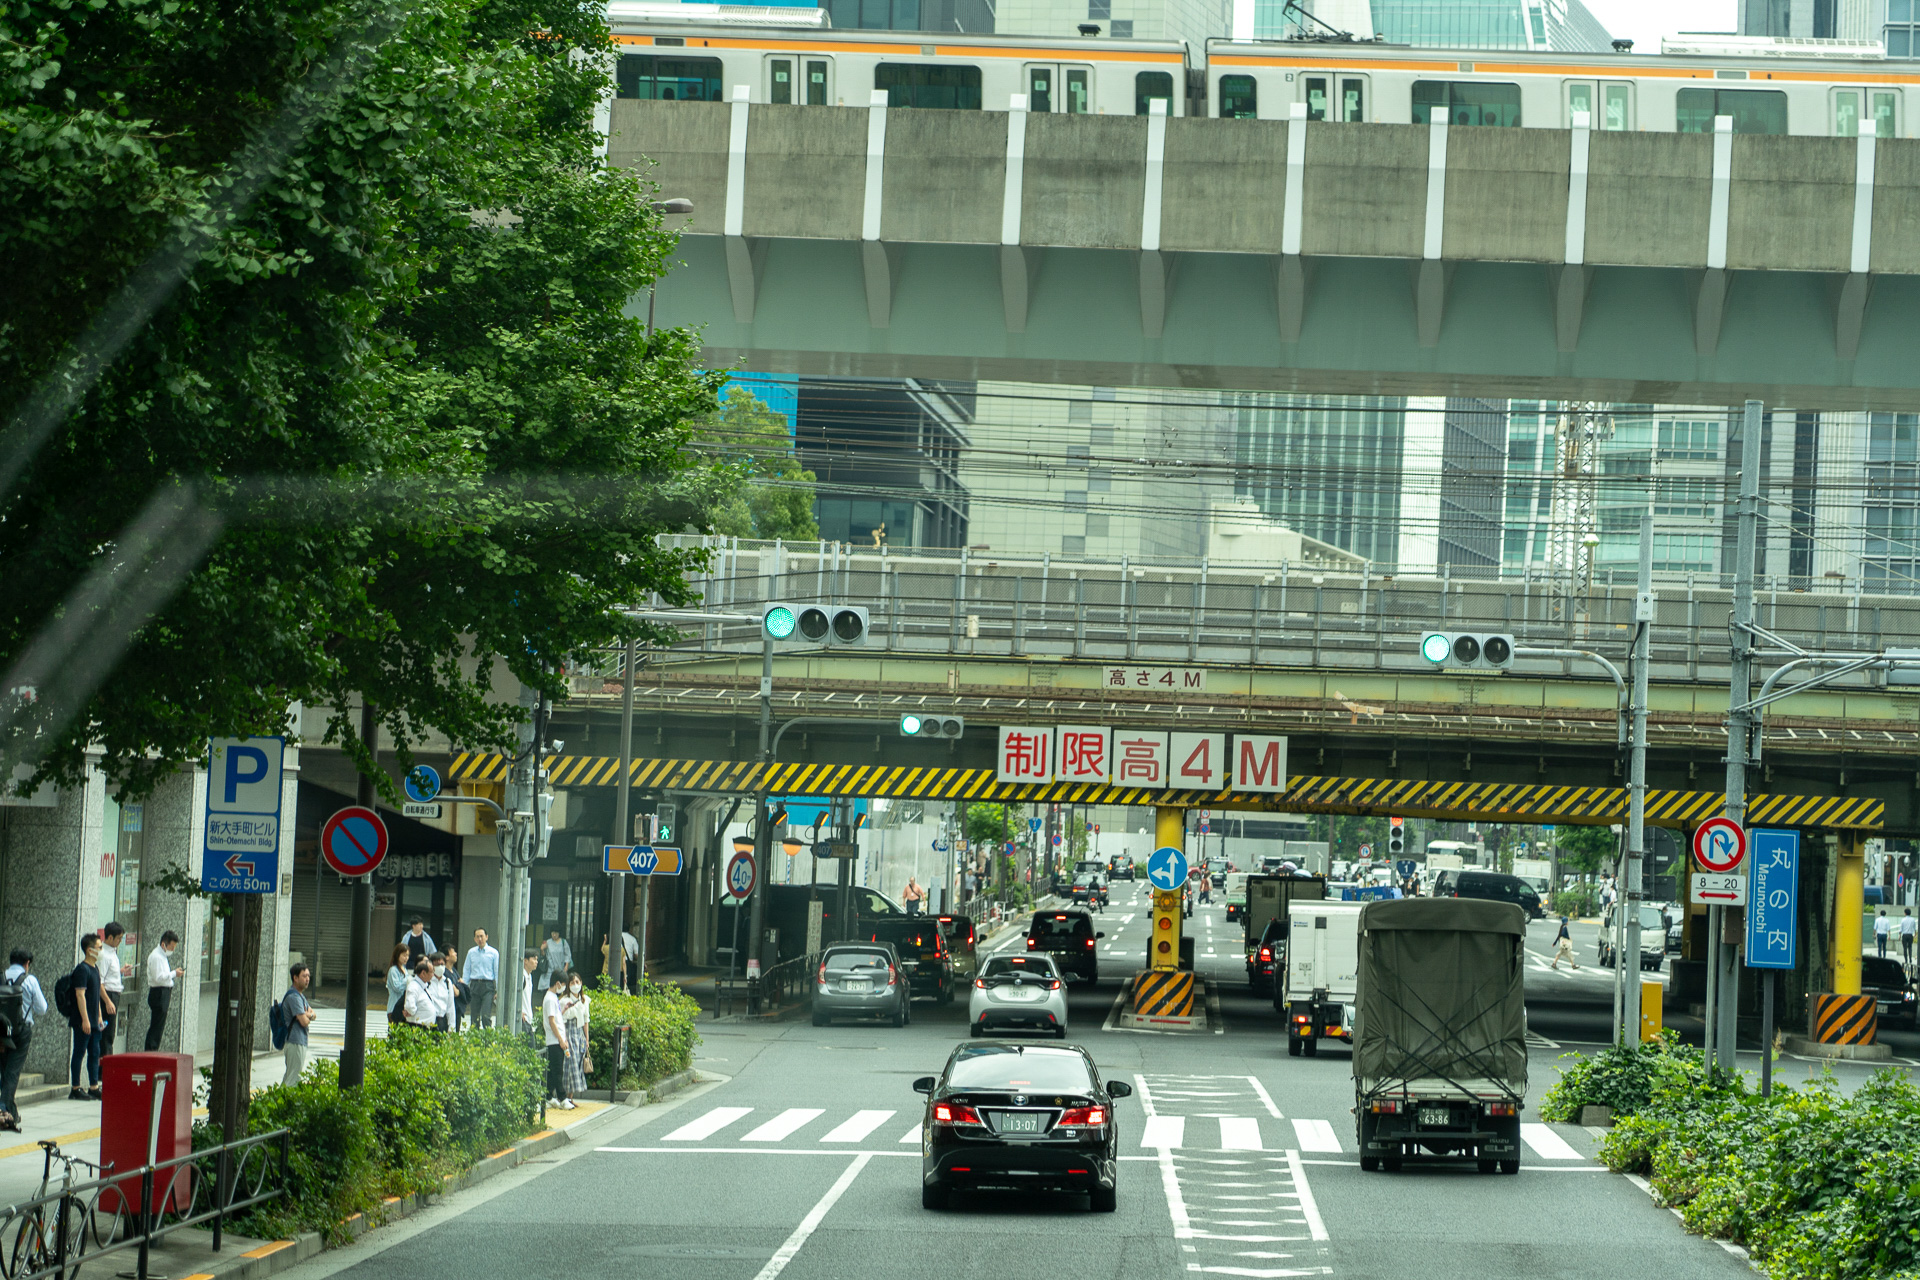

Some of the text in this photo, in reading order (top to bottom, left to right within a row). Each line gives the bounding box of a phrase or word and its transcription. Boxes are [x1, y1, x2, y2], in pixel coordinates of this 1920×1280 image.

[1109, 669, 1201, 688] 高さ4M
[1005, 731, 1280, 787] 制限高4M
[224, 745, 269, 803] P
[405, 803, 435, 815] 自転車通行可
[209, 820, 275, 837] 新大手町ビル
[209, 836, 274, 847] Shin-Otemachi Bldg.
[630, 852, 655, 868] 407
[1404, 864, 1409, 873] 1
[1756, 863, 1769, 934] Marunouchi
[1768, 847, 1791, 951] 丸の内
[1484, 1144, 1515, 1152] ELF
